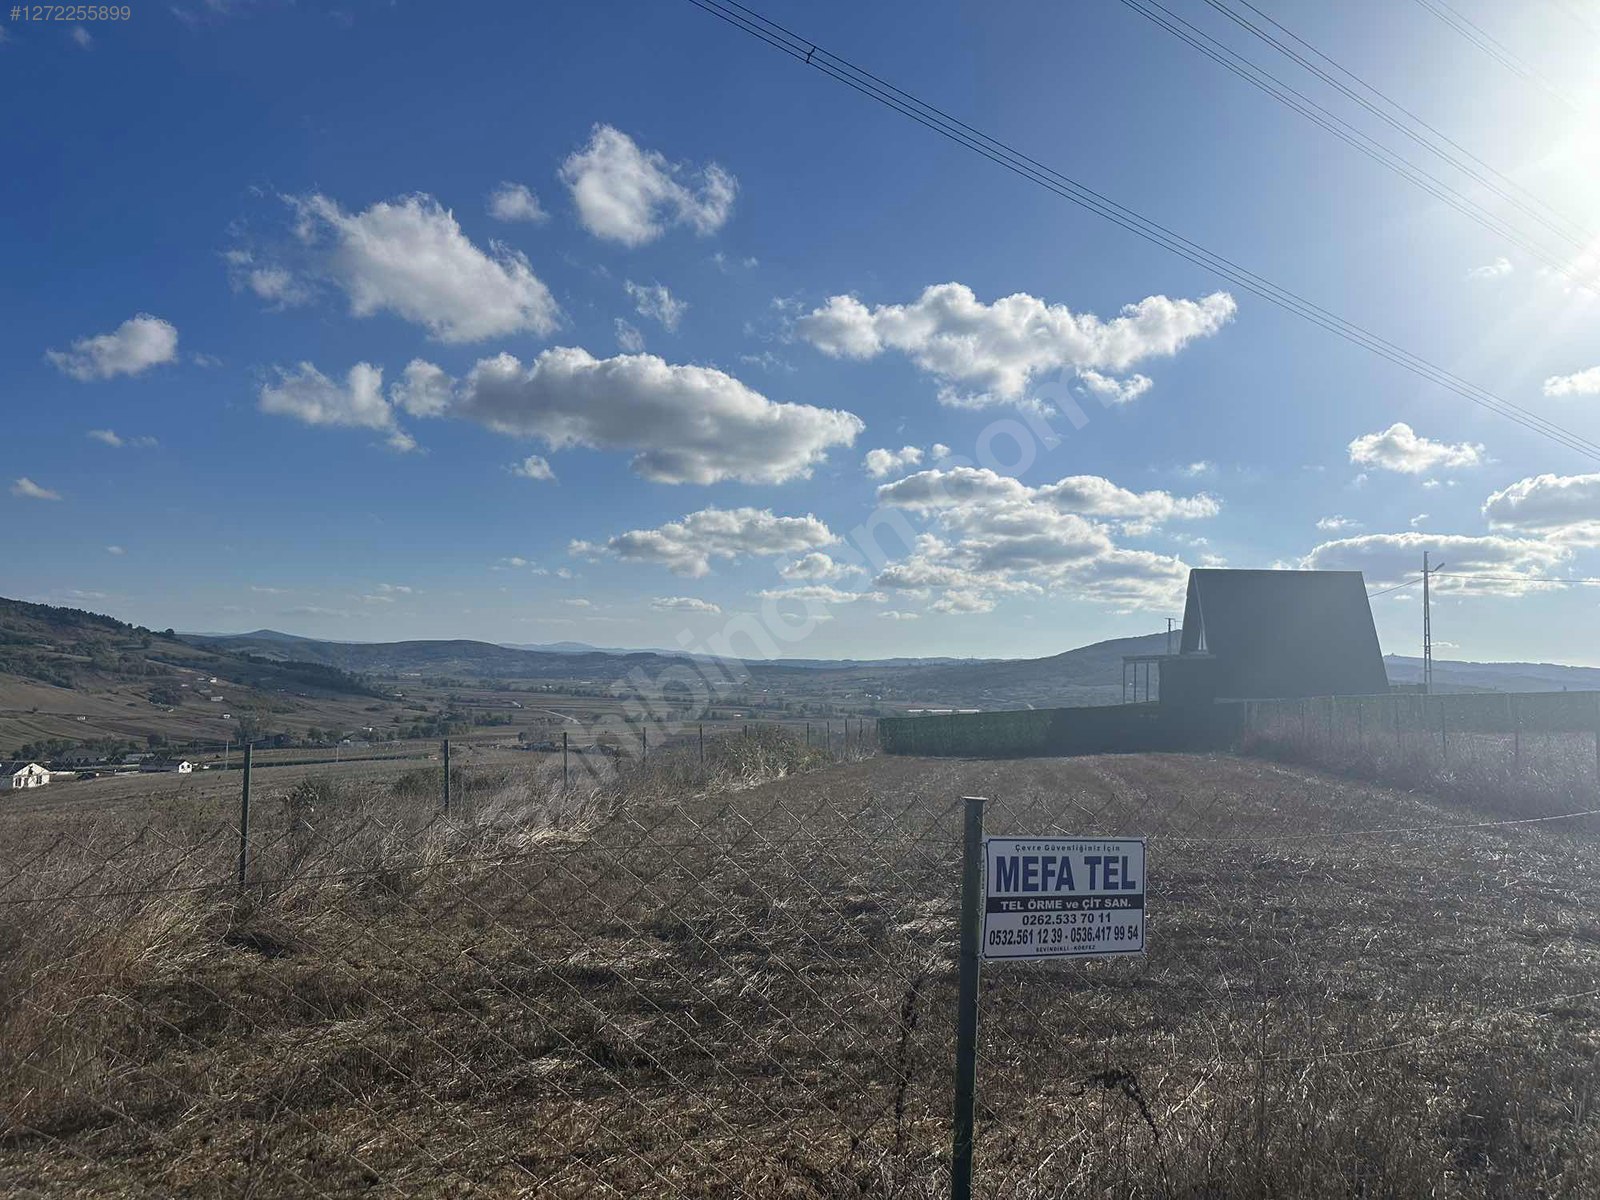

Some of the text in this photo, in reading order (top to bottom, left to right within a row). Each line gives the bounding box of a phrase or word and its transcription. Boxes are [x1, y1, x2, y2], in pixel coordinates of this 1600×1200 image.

[1015, 844, 1041, 852] Çevre
[996, 856, 1136, 892] MEFA TEL
[1000, 897, 1131, 910] TEL ÖRME ve ÇİT SAN.
[1022, 912, 1111, 925] 0262.533 70 11
[989, 929, 1033, 946] 0532.561
[1038, 929, 1049, 944] 12
[1051, 928, 1062, 944] 39
[1070, 927, 1111, 943] 0536.417
[1114, 926, 1125, 941] 99
[1127, 925, 1139, 940] 54
